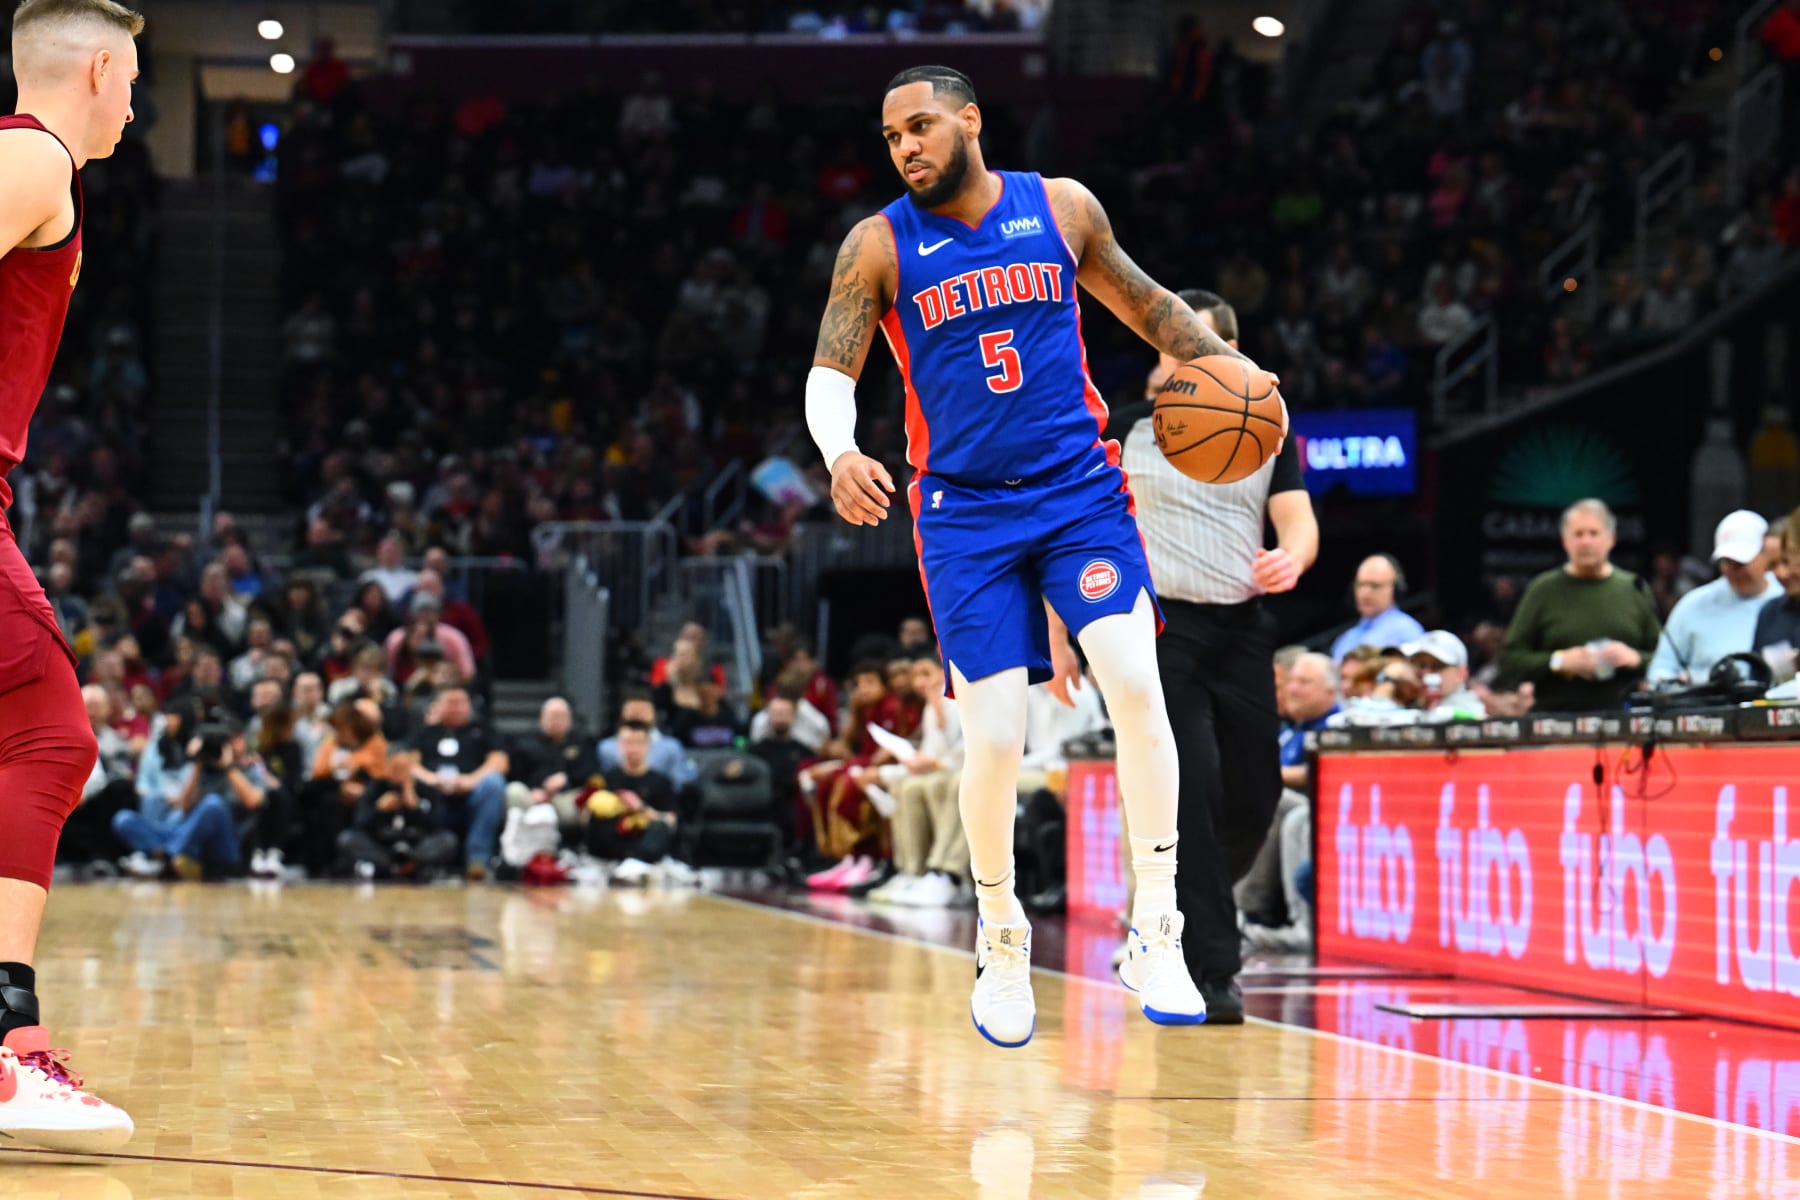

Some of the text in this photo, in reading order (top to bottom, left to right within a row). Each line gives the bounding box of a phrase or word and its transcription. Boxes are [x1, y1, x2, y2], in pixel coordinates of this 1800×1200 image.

[1001, 216, 1041, 234] UWM
[912, 262, 1062, 331] DETROIT
[979, 329, 1023, 394] 5
[1306, 435, 1406, 470] ULTRA
[1335, 782, 1415, 944] fubo
[1436, 782, 1532, 960] fubo
[1560, 782, 1676, 979] fubo
[1710, 783, 1800, 998] fub
